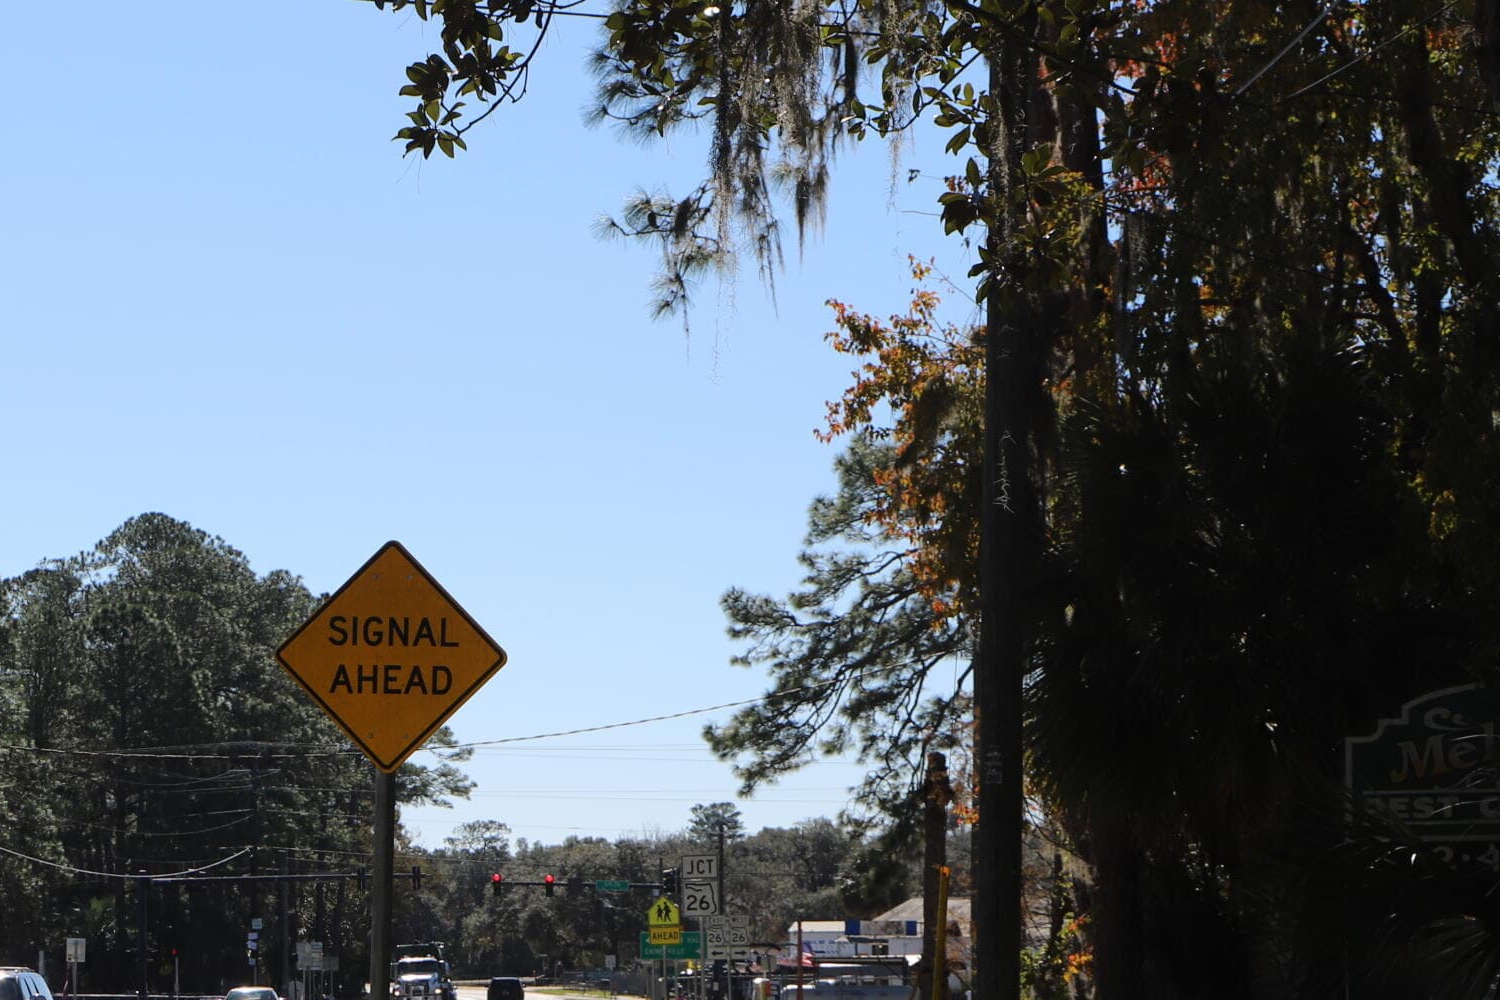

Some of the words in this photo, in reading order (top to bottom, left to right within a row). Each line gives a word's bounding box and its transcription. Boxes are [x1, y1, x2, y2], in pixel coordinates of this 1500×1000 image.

[328, 616, 460, 647] SIGNAL
[329, 664, 453, 696] AHEAD
[687, 859, 714, 875] JCT
[686, 895, 710, 911] 26
[652, 931, 679, 941] AHEAD
[708, 933, 722, 943] 26
[732, 933, 746, 943] 26
